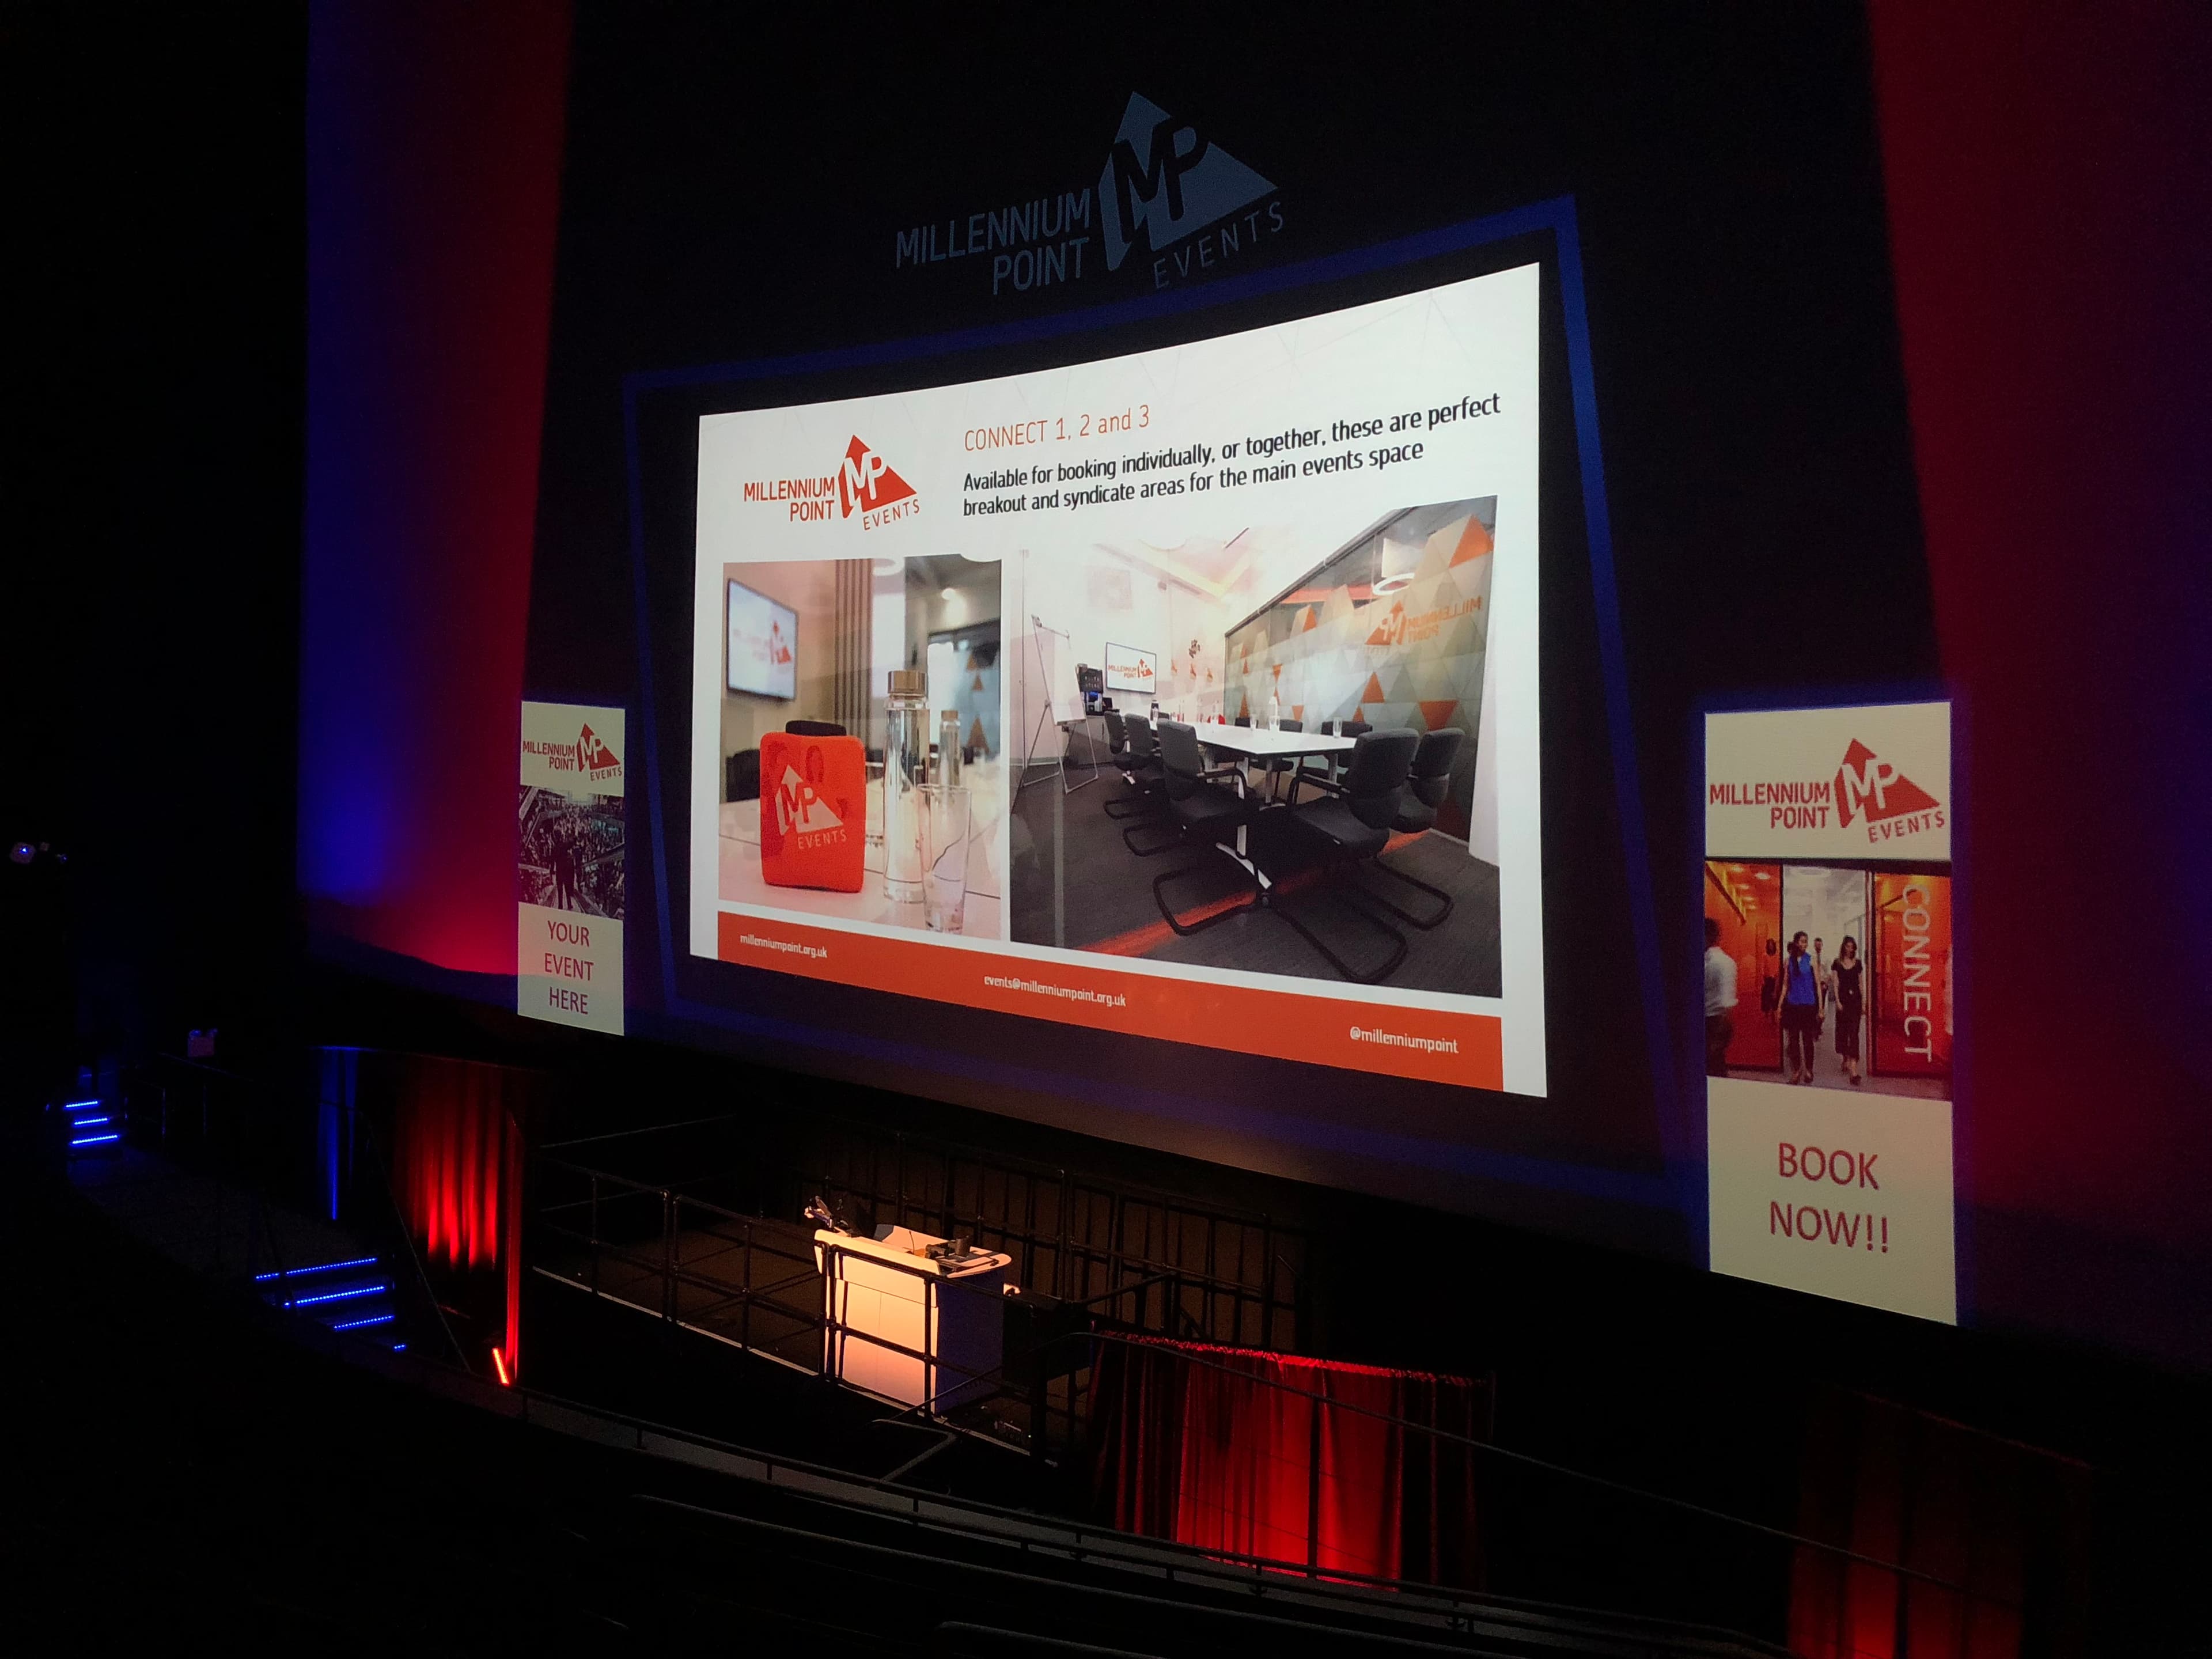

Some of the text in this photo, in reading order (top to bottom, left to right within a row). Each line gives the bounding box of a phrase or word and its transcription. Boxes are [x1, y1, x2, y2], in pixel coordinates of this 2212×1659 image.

[896, 187, 1091, 270] MILLENNIUM
[1153, 200, 1283, 289] EVENTS
[992, 236, 1090, 296] POINT
[965, 404, 1149, 451] CONNECT 1, 2 and 3
[964, 393, 1501, 491] Available for booking individually, or together, these are perfect
[744, 476, 835, 502] MILLENNIUM
[963, 442, 1423, 516] breakout and syndicate areas for the main events space
[789, 499, 834, 522] POINT
[863, 499, 921, 531] EVENTS
[522, 741, 575, 757] MILLENNIUM
[549, 757, 574, 771] POINT
[590, 767, 622, 782] EVENTS
[1710, 781, 1830, 805] MILLENNIUM
[1770, 806, 1830, 830] POINT
[1868, 811, 1945, 843] EVENTS
[797, 828, 847, 850] EVENTS
[547, 920, 590, 947] YOUR
[740, 934, 827, 959] millenniumpoint.org.uk
[544, 953, 594, 981] EVENT
[1902, 884, 1932, 1063] CONNECT
[549, 986, 588, 1014] HERE
[984, 975, 1126, 1007] events@millenniumpoint.org.uk
[1350, 1026, 1459, 1054] @millenniumpoint
[1778, 1142, 1880, 1190] BOOK
[1770, 1200, 1888, 1253] NOW!!
